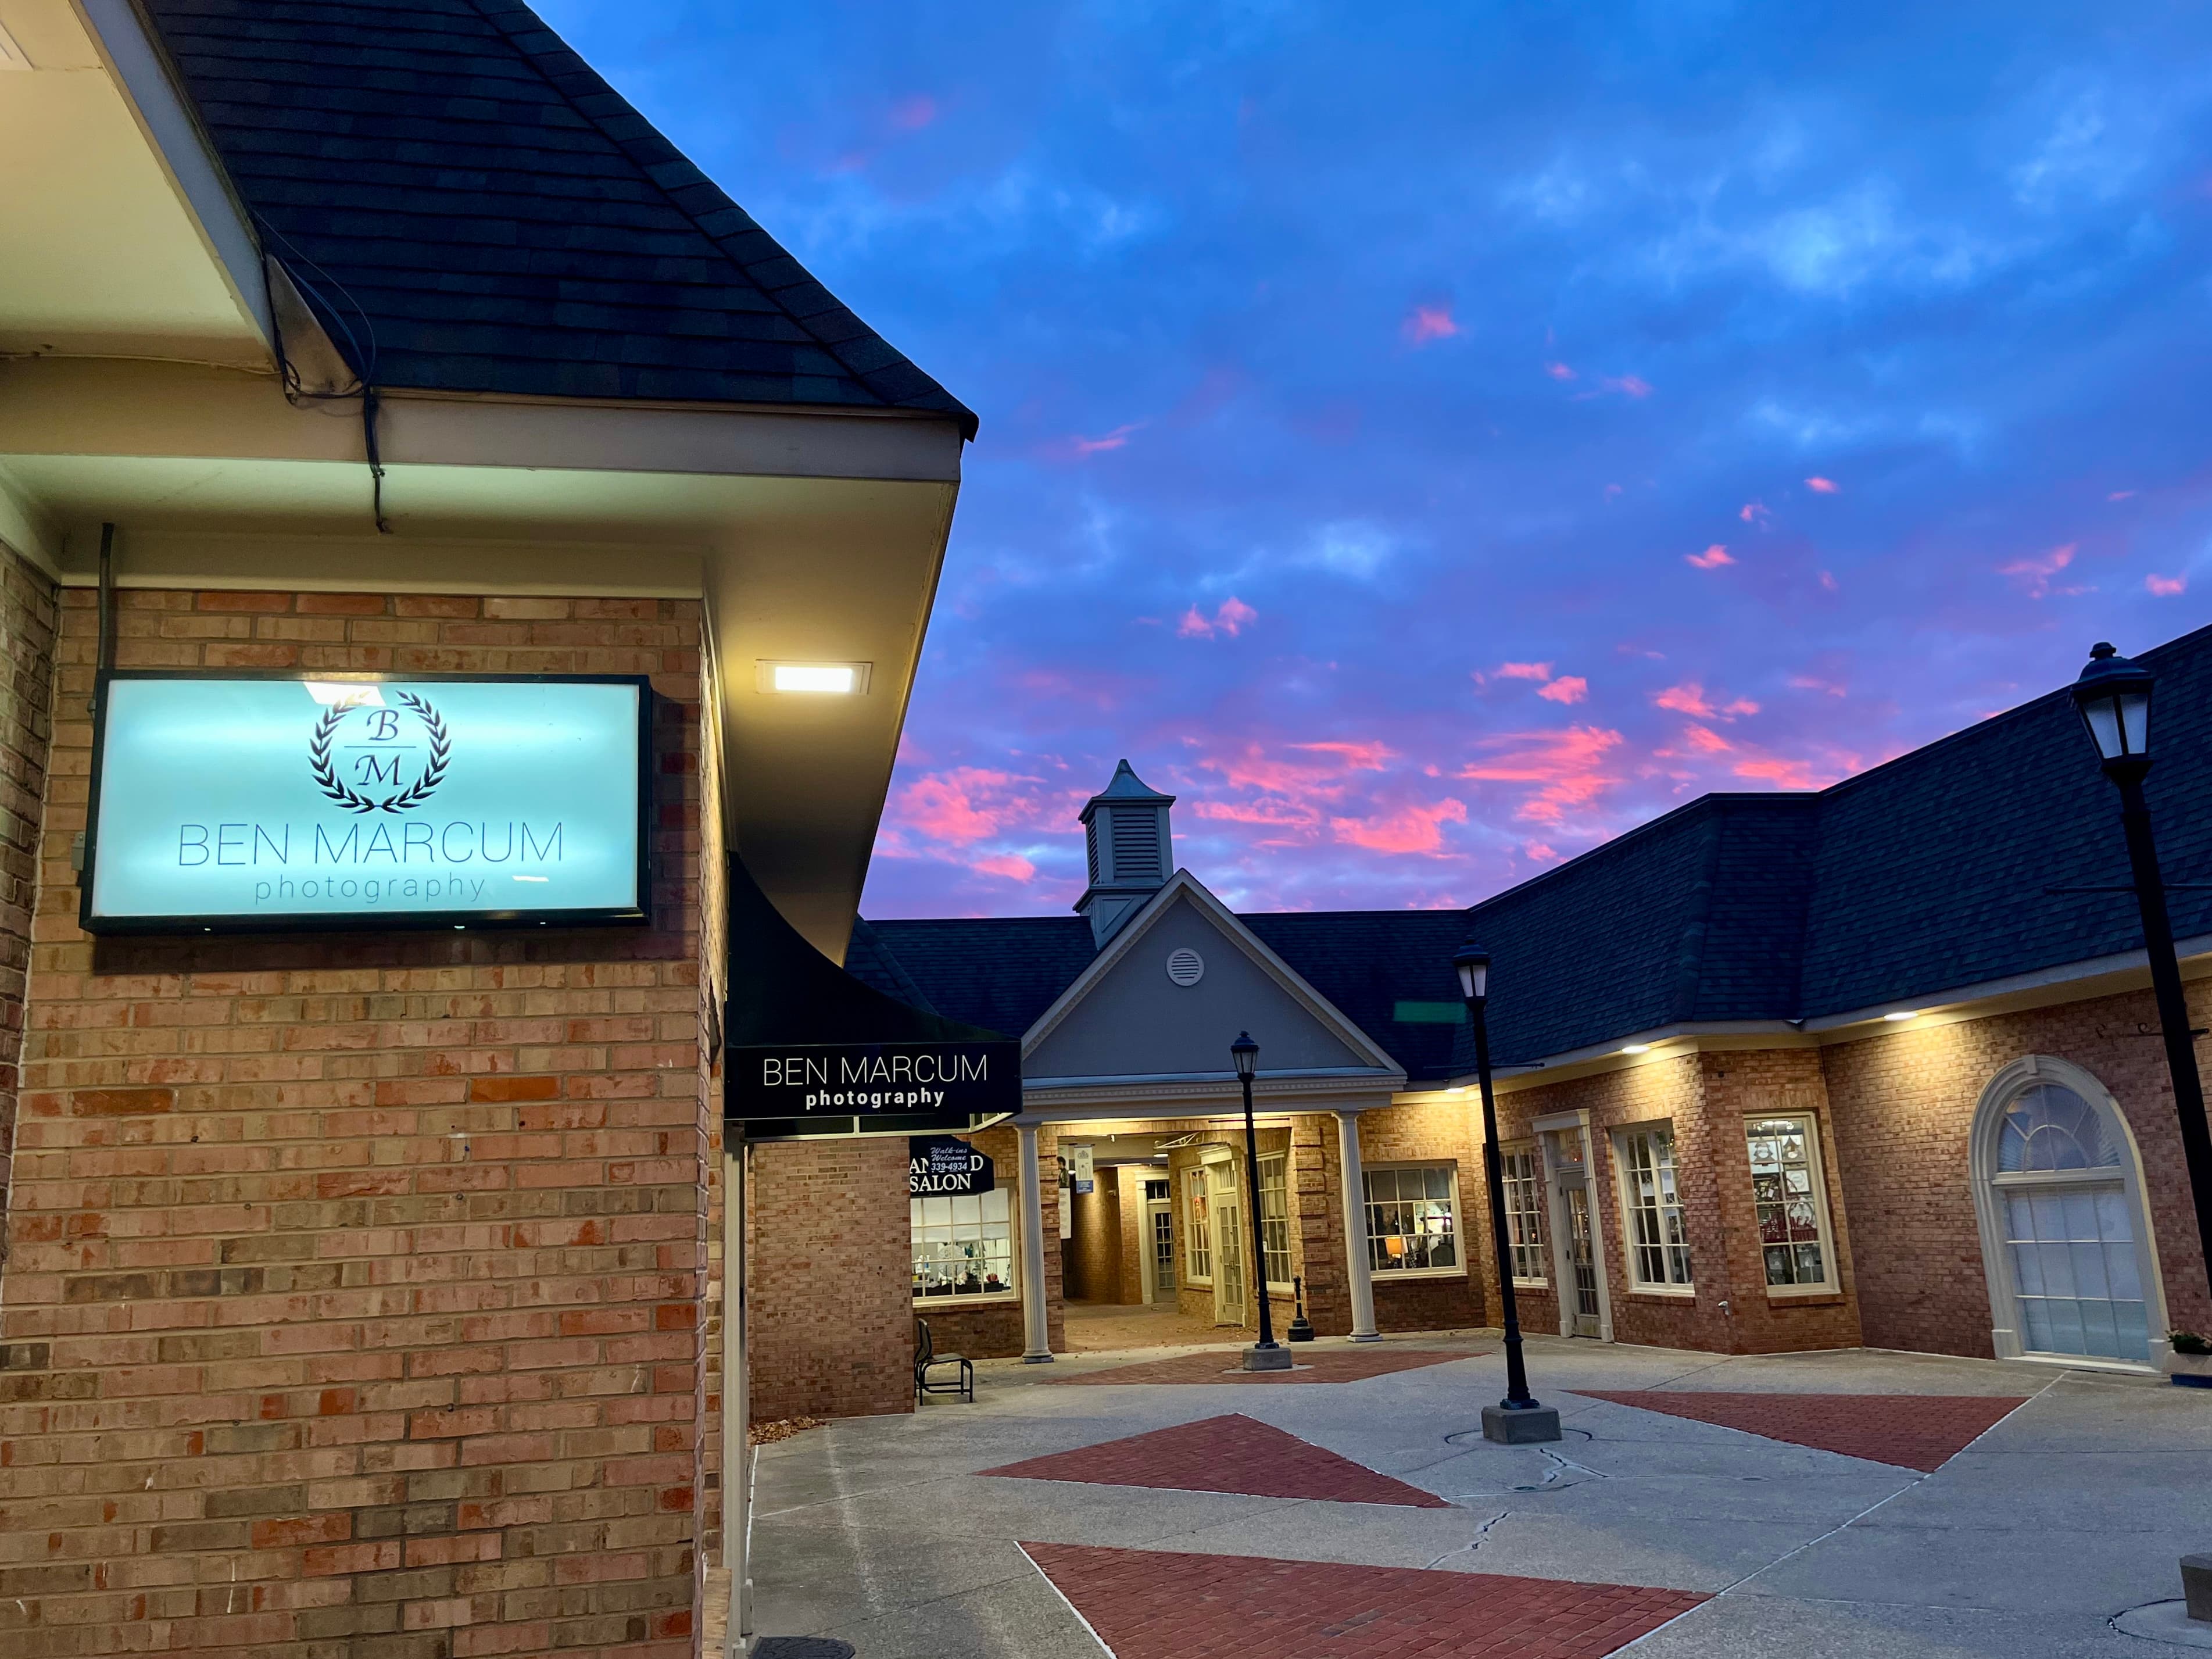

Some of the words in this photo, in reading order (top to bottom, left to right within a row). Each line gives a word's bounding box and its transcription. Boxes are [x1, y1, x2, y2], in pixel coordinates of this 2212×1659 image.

[366, 709, 399, 742] B
[354, 753, 404, 787] M
[178, 824, 290, 866] BEN
[314, 821, 563, 864] MARCUM
[255, 872, 486, 905] photography
[764, 1057, 828, 1086] BEN
[841, 1054, 987, 1084] MARCUM
[806, 1087, 945, 1110] photography
[910, 1173, 972, 1192] SALON
[930, 1162, 968, 1171] 339-4934
